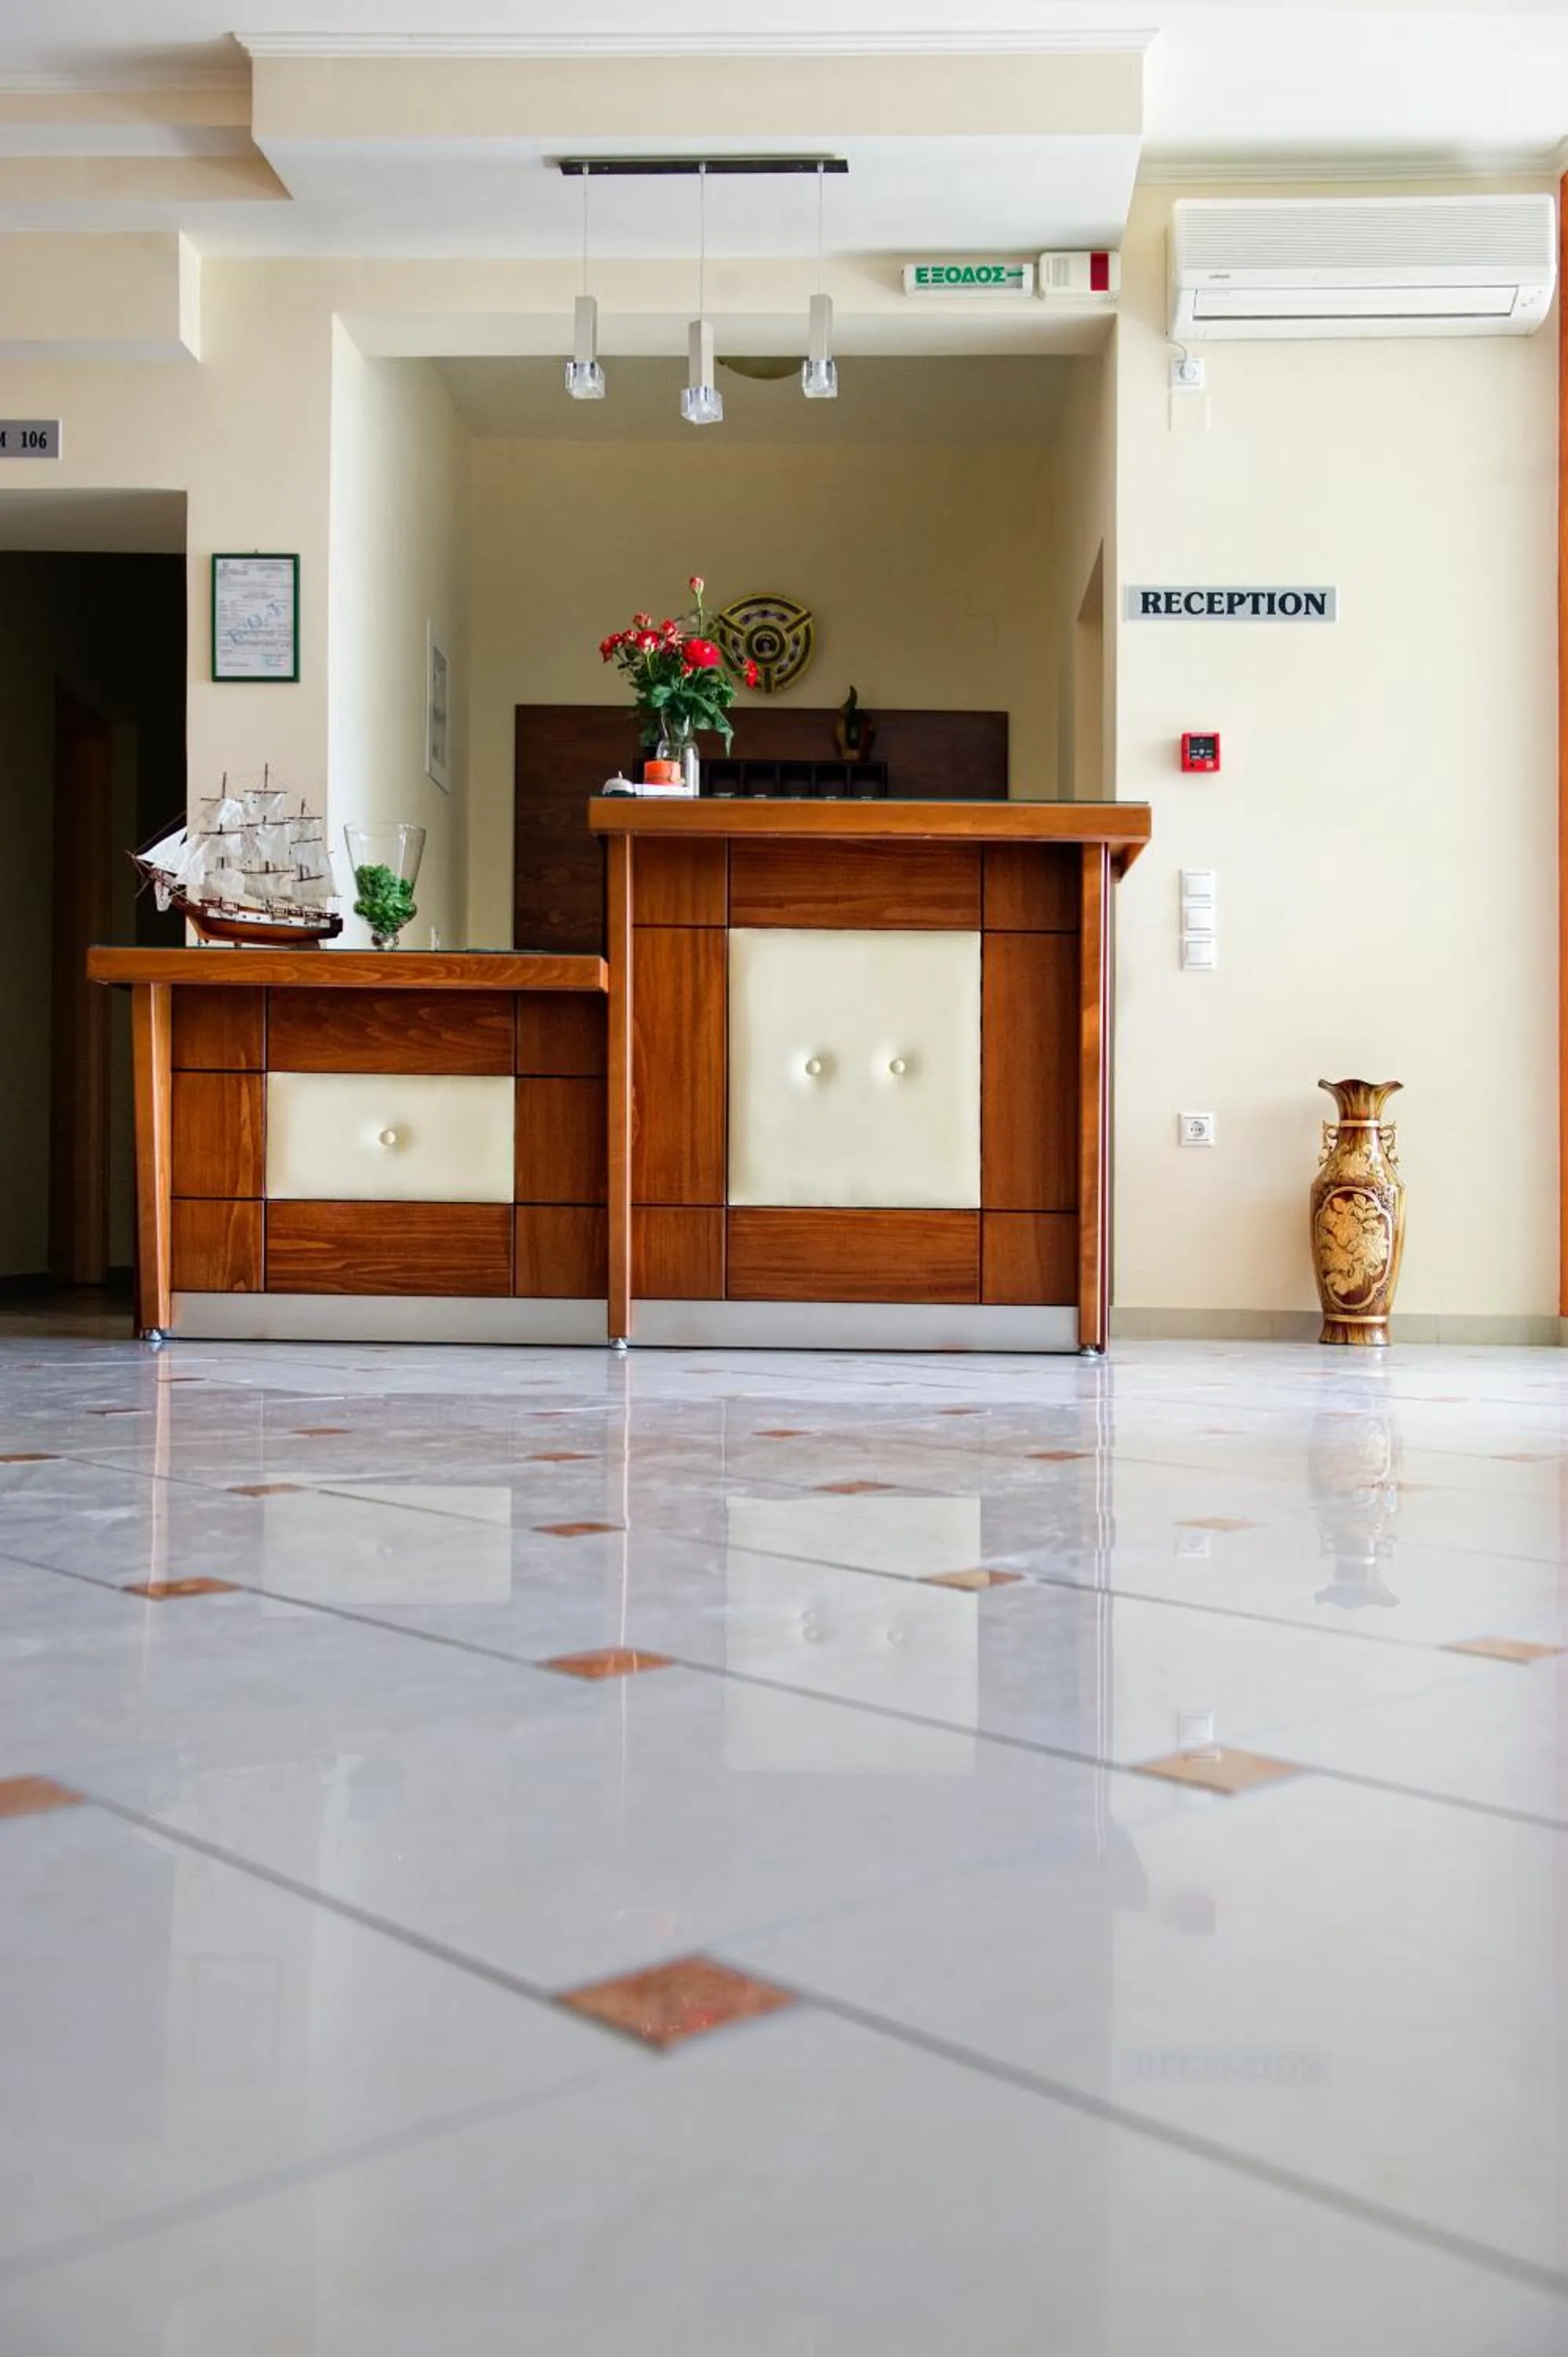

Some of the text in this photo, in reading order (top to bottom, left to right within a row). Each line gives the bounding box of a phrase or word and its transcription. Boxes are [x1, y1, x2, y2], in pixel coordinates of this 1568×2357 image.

[916, 266, 1005, 283] ΕΞΟΔΟΣ
[20, 431, 47, 449] 106
[1141, 592, 1327, 615] RECEPTION
